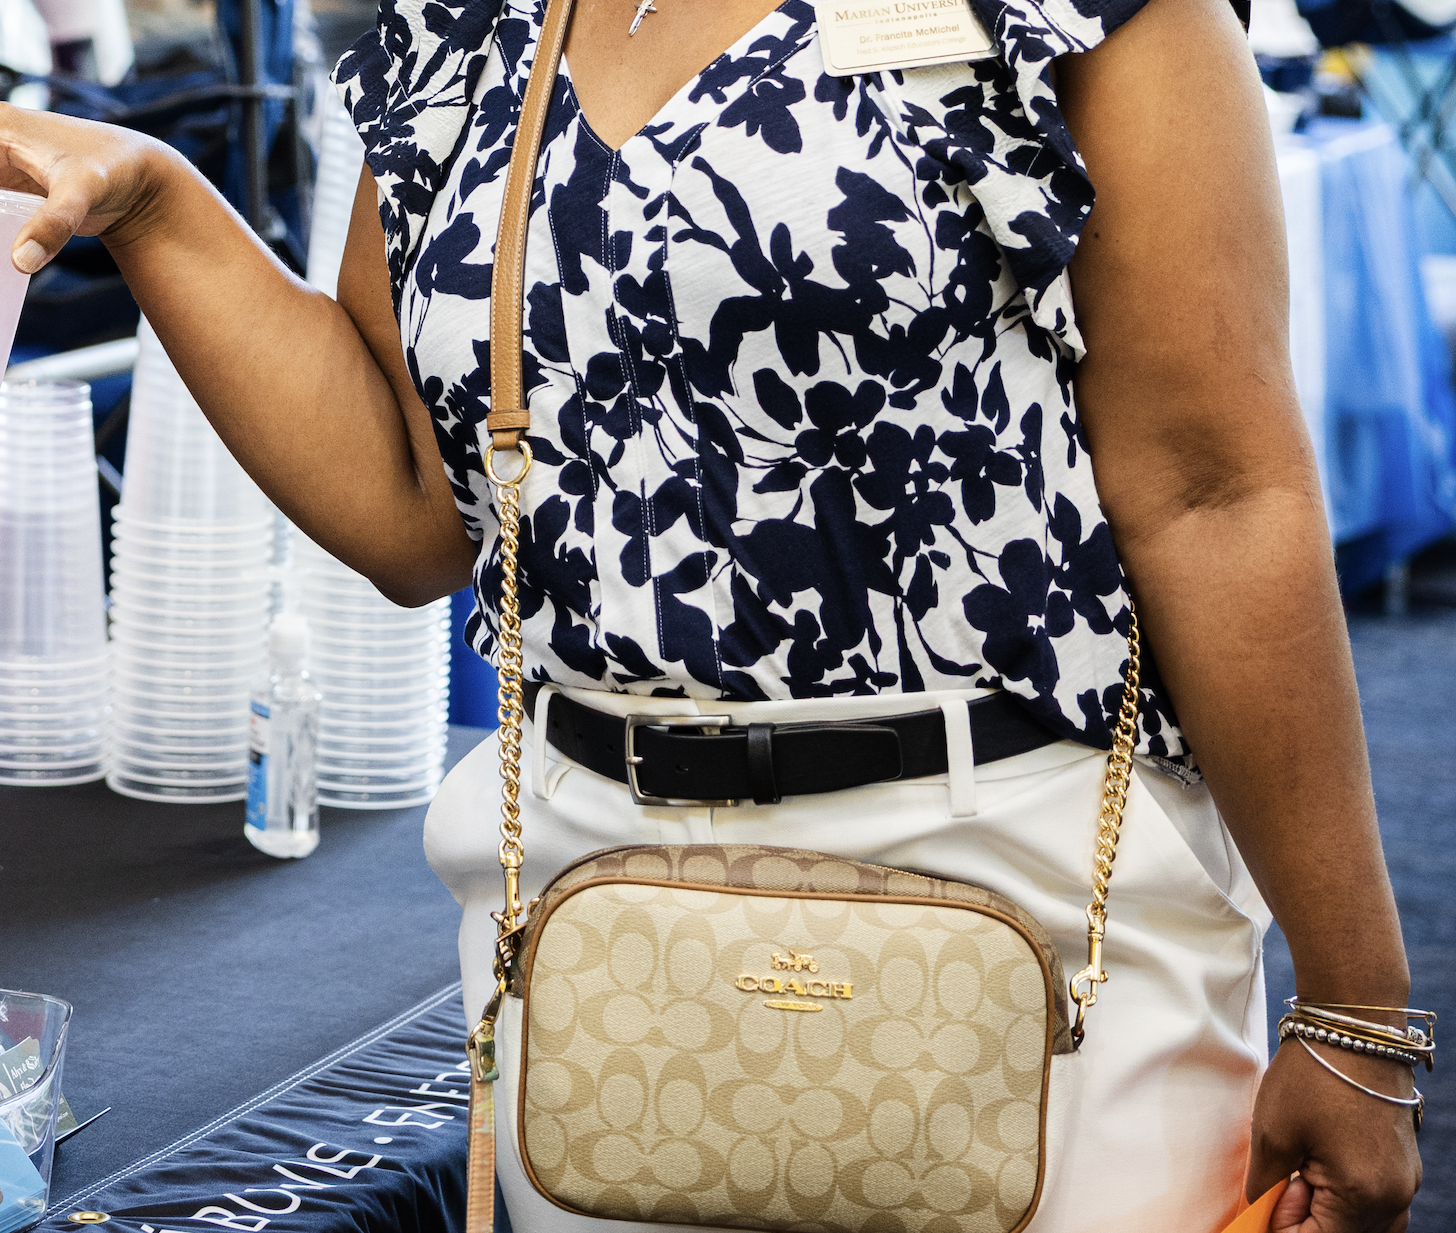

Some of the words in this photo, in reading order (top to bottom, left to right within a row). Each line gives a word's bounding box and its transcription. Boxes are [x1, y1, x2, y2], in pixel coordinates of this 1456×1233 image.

[835, 6, 891, 22] MARIAN
[859, 35, 873, 44] Dr.
[875, 30, 913, 42] Francita
[916, 24, 960, 37] McMichel
[734, 974, 853, 999] COACH
